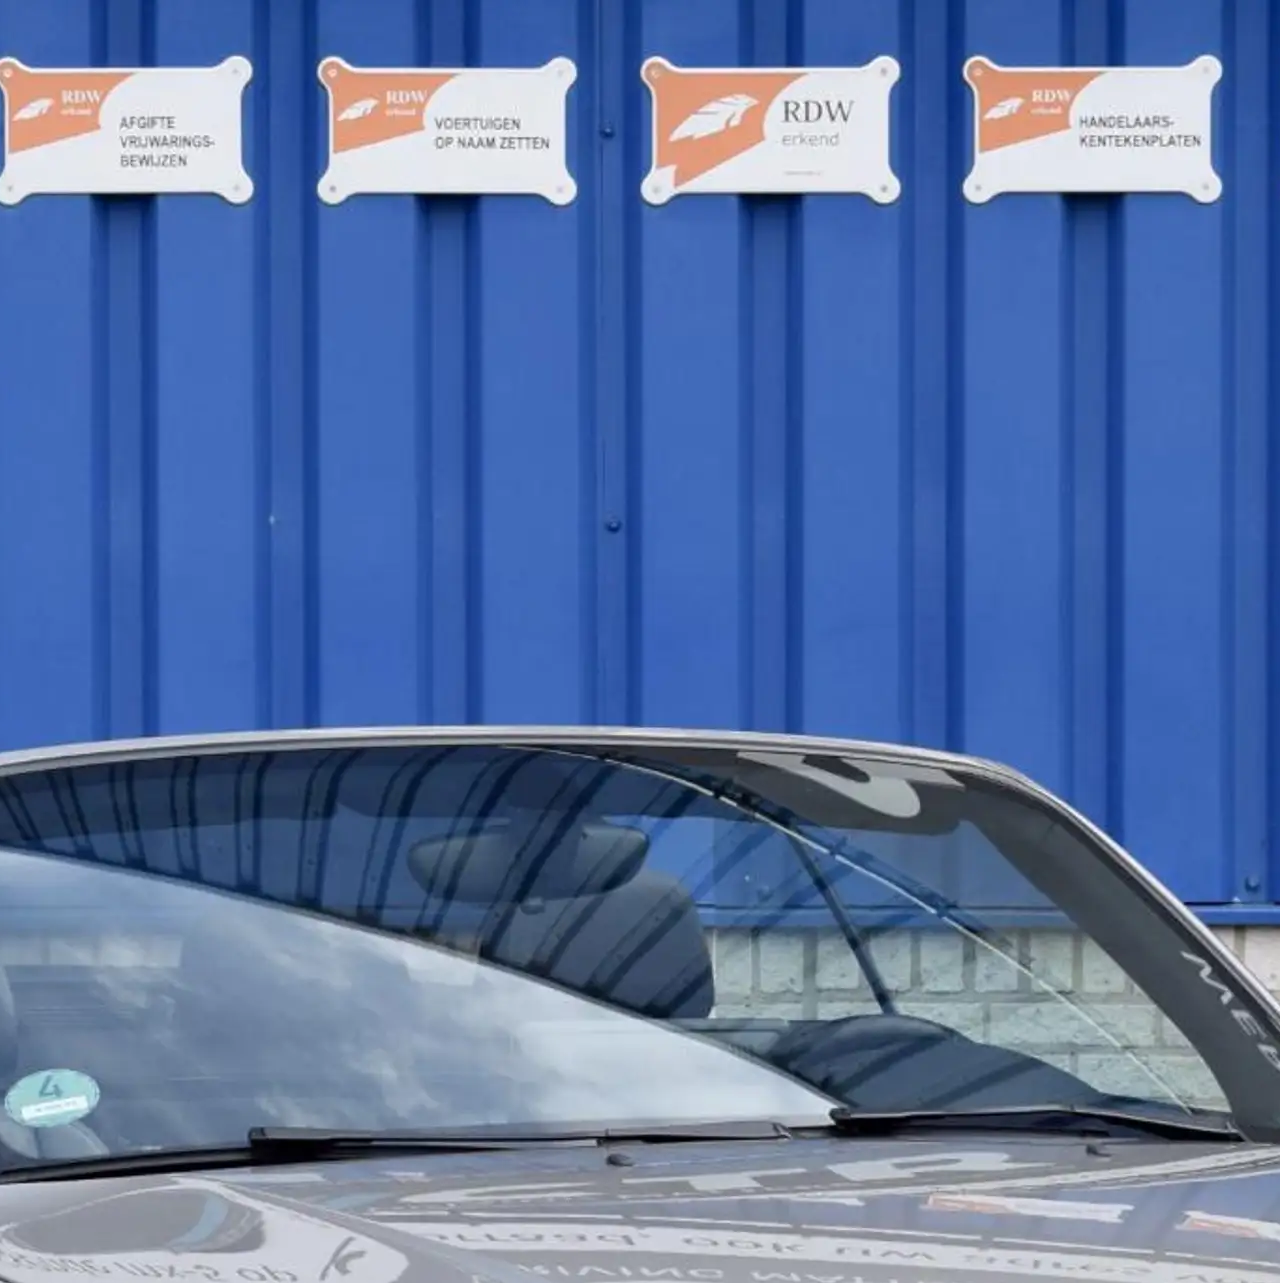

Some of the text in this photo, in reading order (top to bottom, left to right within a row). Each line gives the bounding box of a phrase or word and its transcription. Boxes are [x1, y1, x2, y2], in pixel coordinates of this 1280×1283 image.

[61, 89, 101, 104] RDW
[386, 89, 427, 104] RDW
[1032, 88, 1073, 103] RDW
[781, 99, 855, 123] RDW
[120, 116, 176, 129] AFGIFTE
[434, 117, 521, 130] VOERTUIGEN
[1079, 115, 1175, 129] HANDELAARS-
[120, 135, 216, 149] VRIJWARINGS-
[435, 136, 551, 150] OP NAAM ZETTEN
[782, 132, 839, 147] erkend
[1079, 134, 1202, 148] KENTEKENPLATEN
[120, 154, 188, 168] BEWIJZEN
[38, 1073, 64, 1099] 4
